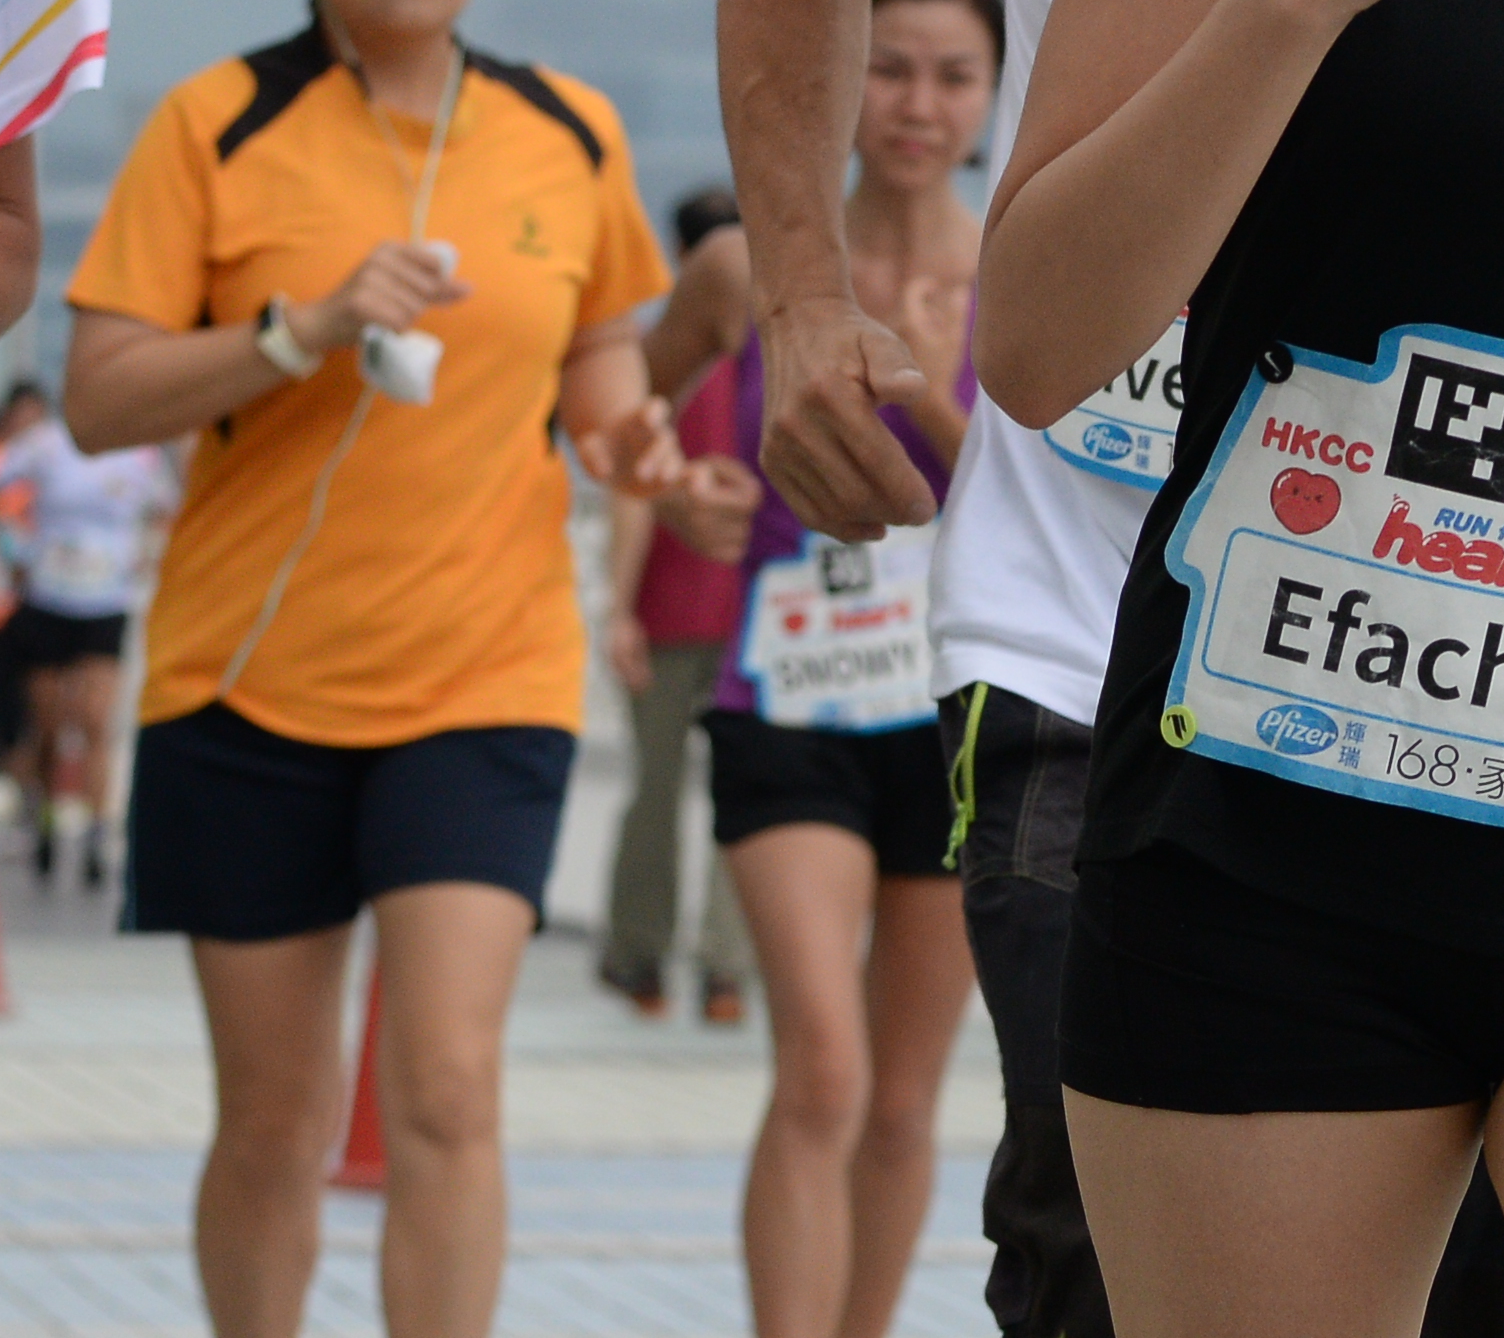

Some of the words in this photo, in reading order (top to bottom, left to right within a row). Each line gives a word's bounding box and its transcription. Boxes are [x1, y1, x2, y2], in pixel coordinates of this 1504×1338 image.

[1261, 416, 1374, 474] HKCC
[1433, 507, 1493, 538] RUN
[1261, 710, 1337, 751] Pfizer
[1337, 720, 1368, 769] 輝瑞
